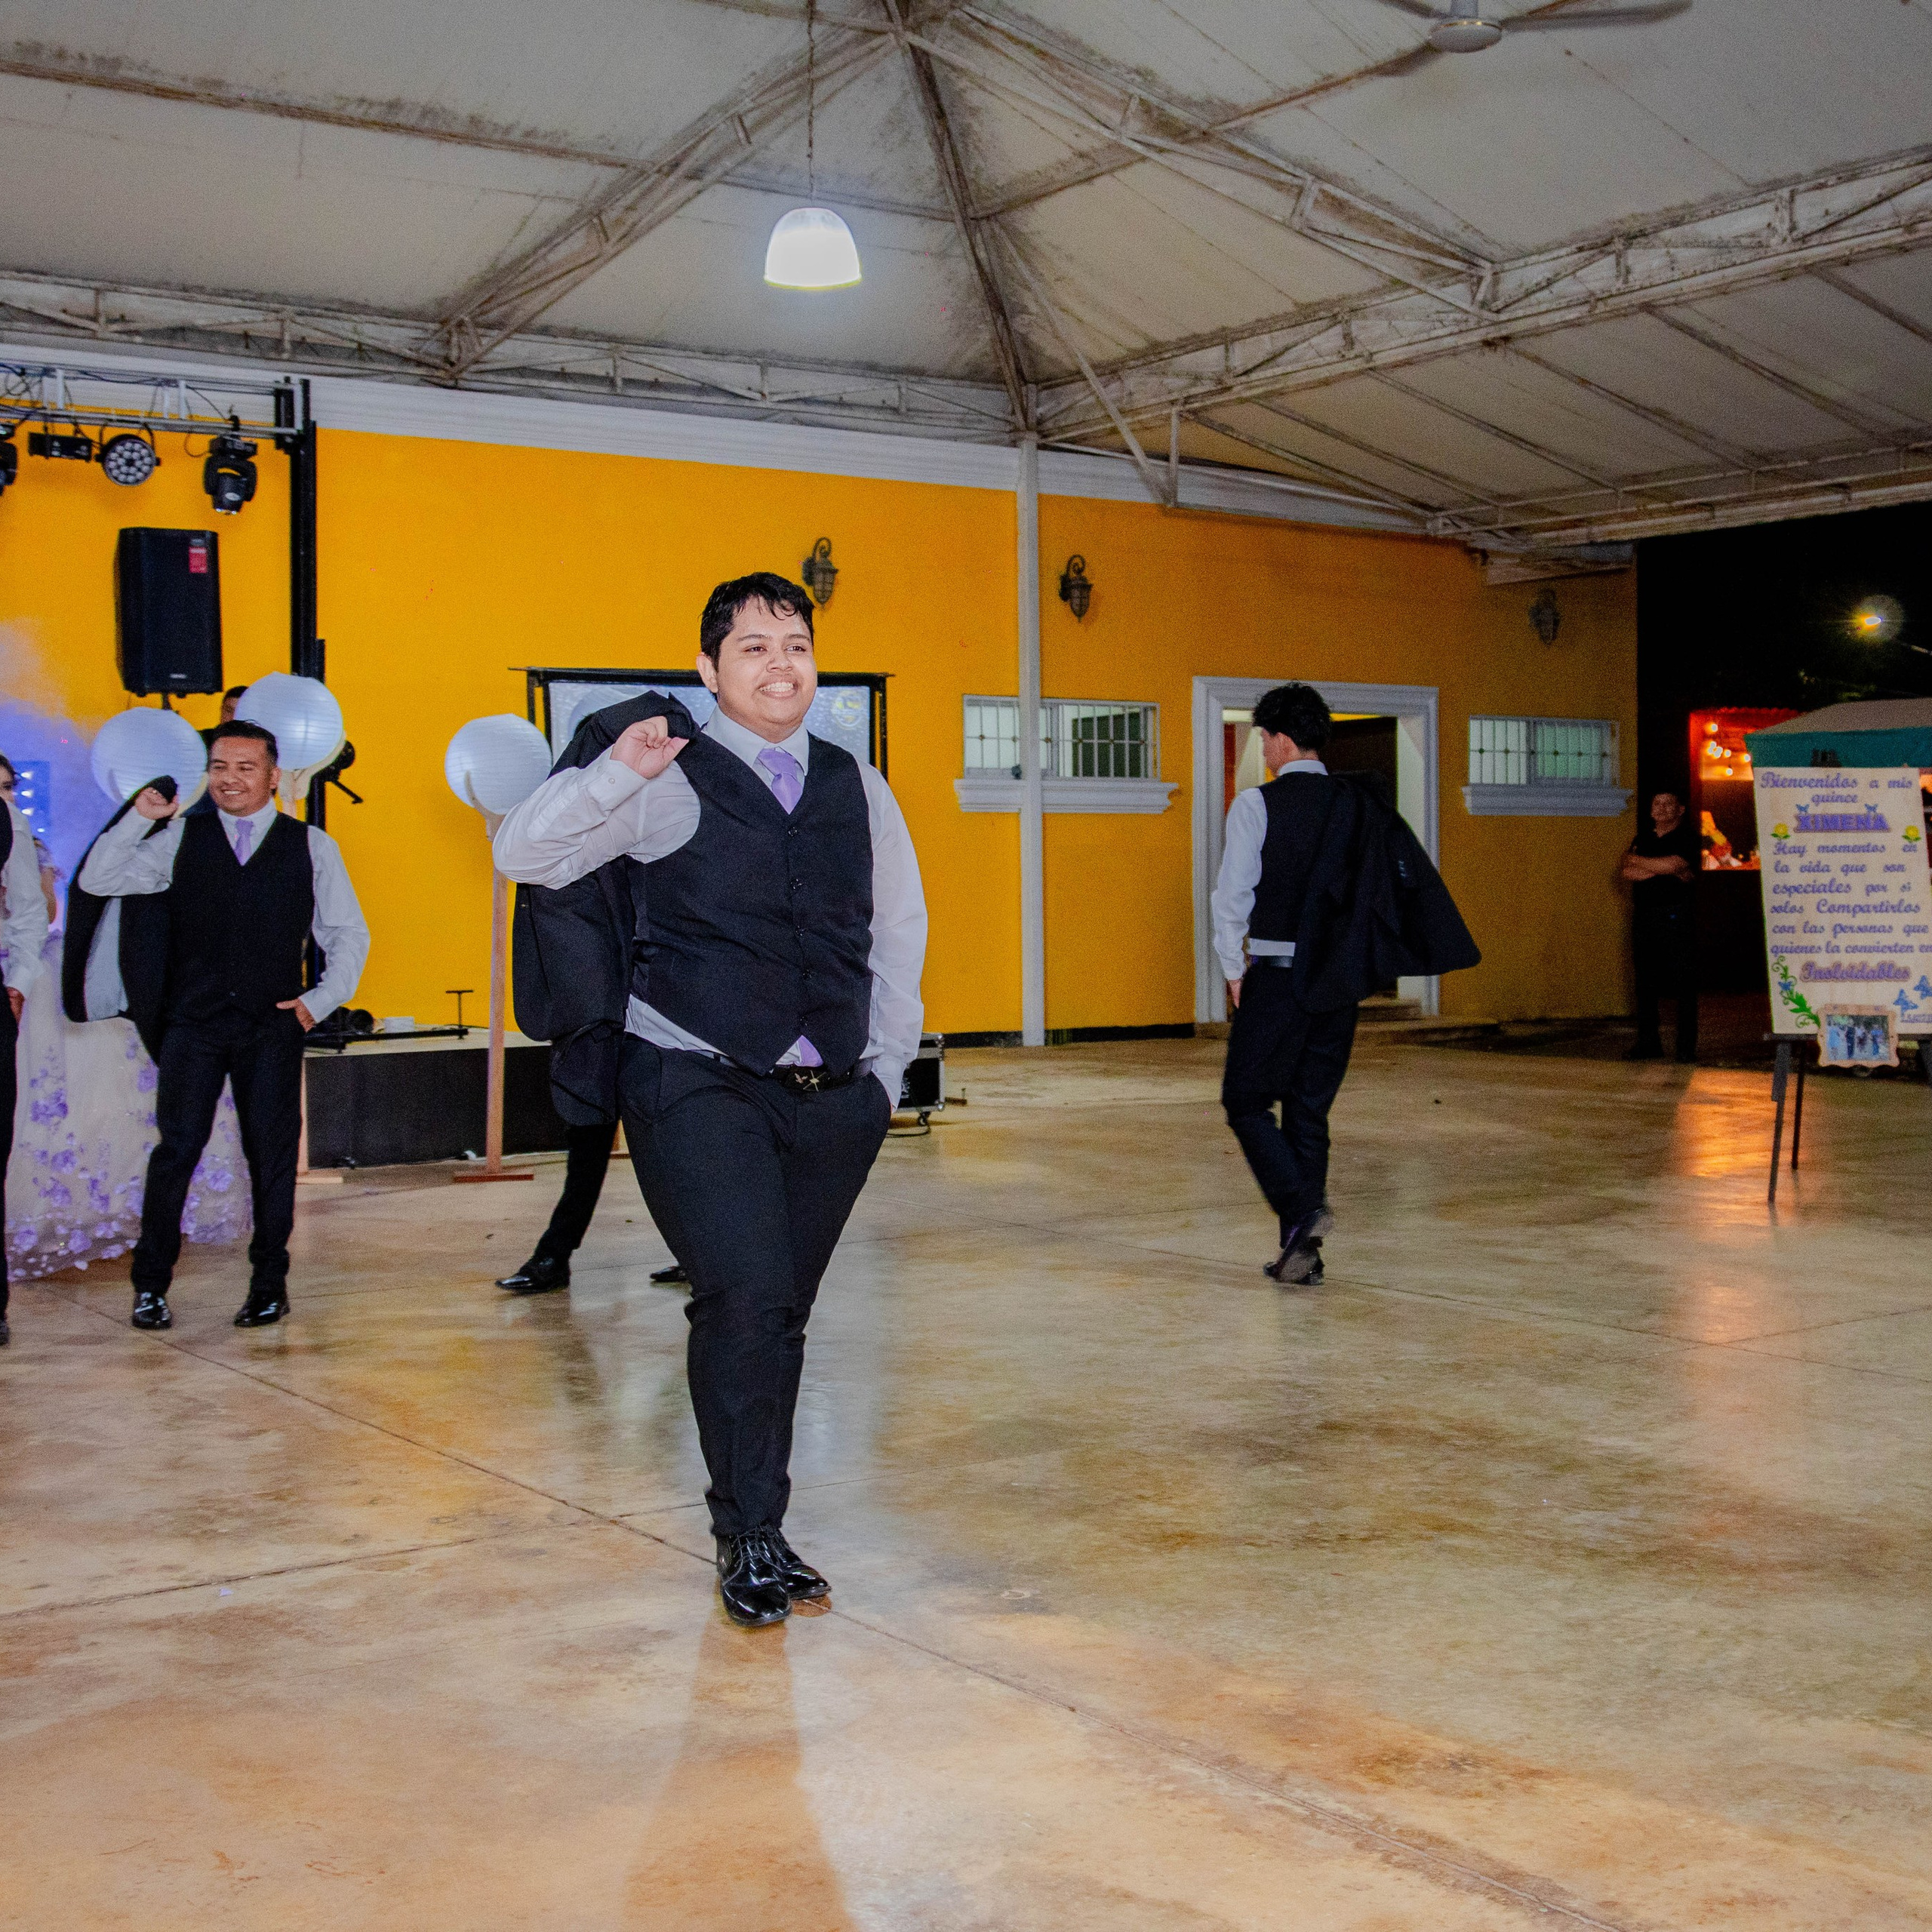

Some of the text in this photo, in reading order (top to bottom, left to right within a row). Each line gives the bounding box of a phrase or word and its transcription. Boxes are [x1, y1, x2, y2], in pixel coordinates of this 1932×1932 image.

[1761, 771, 1913, 789] Bienvenidos a mis
[1812, 791, 1858, 807] quince
[1798, 814, 1889, 831] XIMENA
[1774, 841, 1918, 857] Hay momentos en
[1774, 860, 1907, 876] la vida que son
[1773, 878, 1852, 897] especiales
[1865, 883, 1888, 897] por
[1770, 899, 1921, 918] solos Compartirlos
[1772, 920, 1929, 939] con las personas que
[1770, 941, 1822, 958] quienes
[1825, 940, 1841, 953] la
[1844, 940, 1915, 953] convierten
[1801, 961, 1910, 980] Inolvidables
